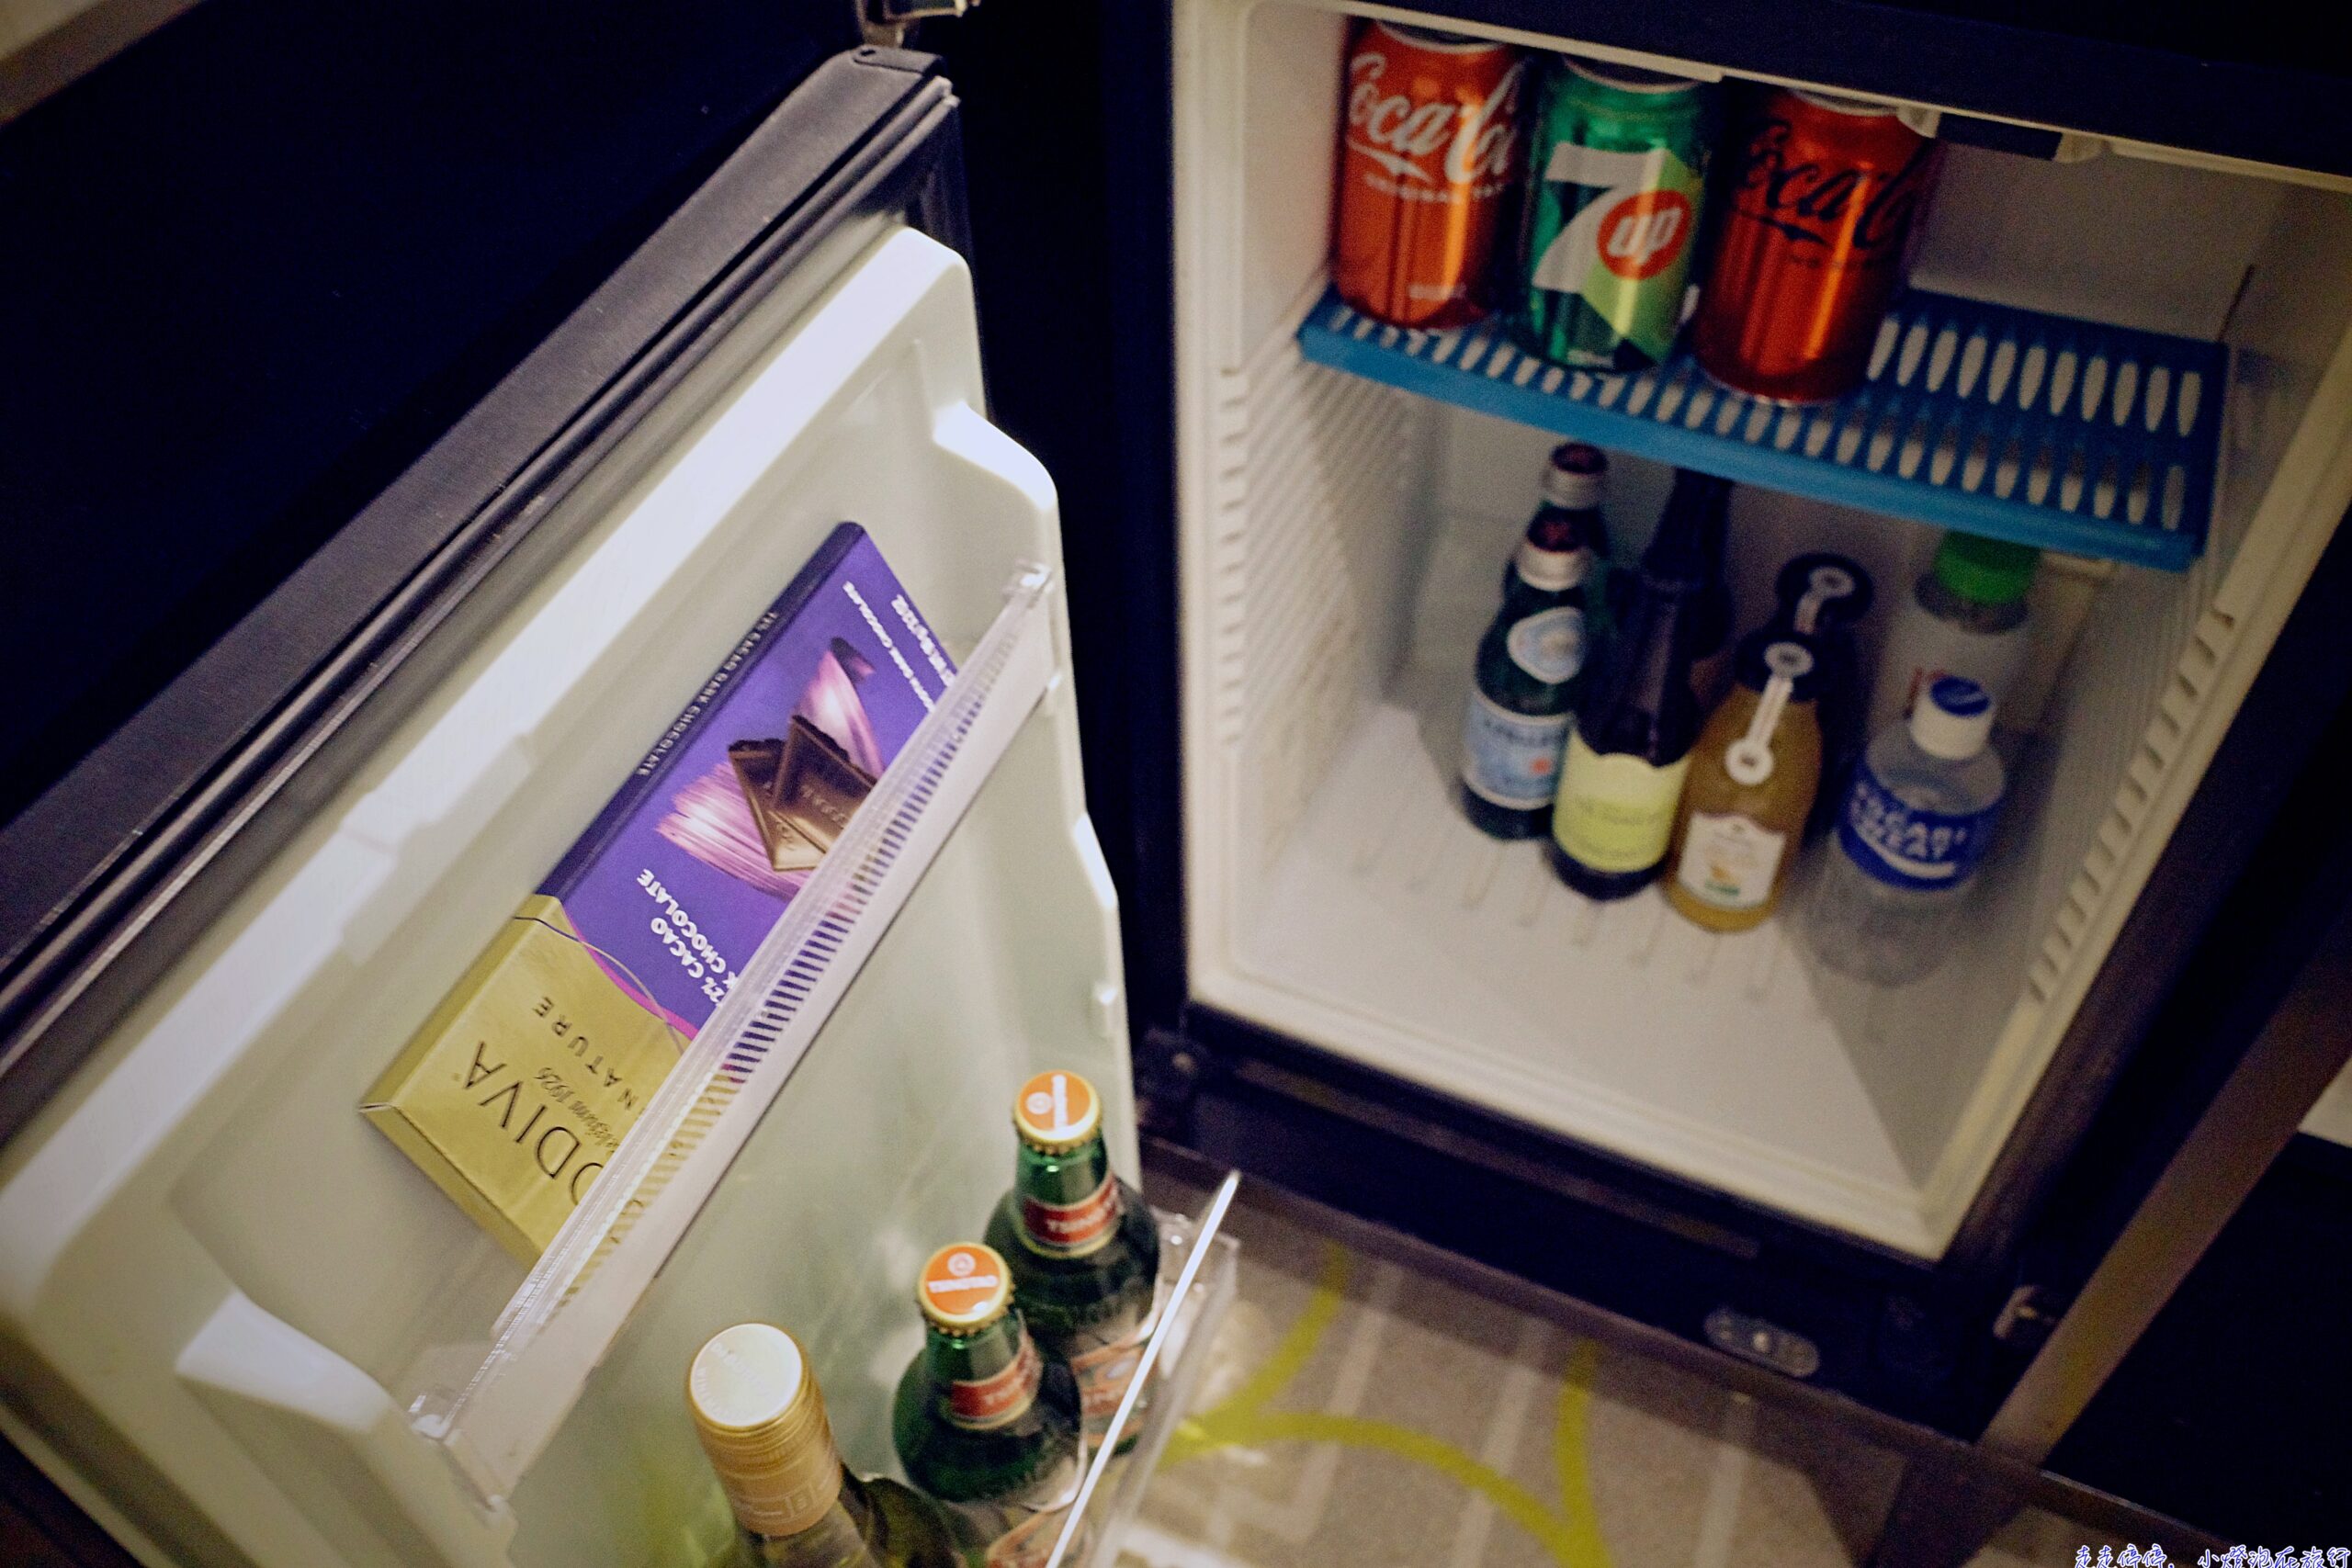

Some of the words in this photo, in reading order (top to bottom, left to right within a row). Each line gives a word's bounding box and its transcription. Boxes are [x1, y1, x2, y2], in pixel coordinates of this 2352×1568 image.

[636, 705, 701, 776] CHOCOLATE
[636, 868, 726, 974] CHOCOLATE
[650, 917, 704, 978] CACAO
[701, 976, 725, 1009] 2%
[532, 997, 645, 1115] NATURE
[533, 1066, 575, 1103] 1926
